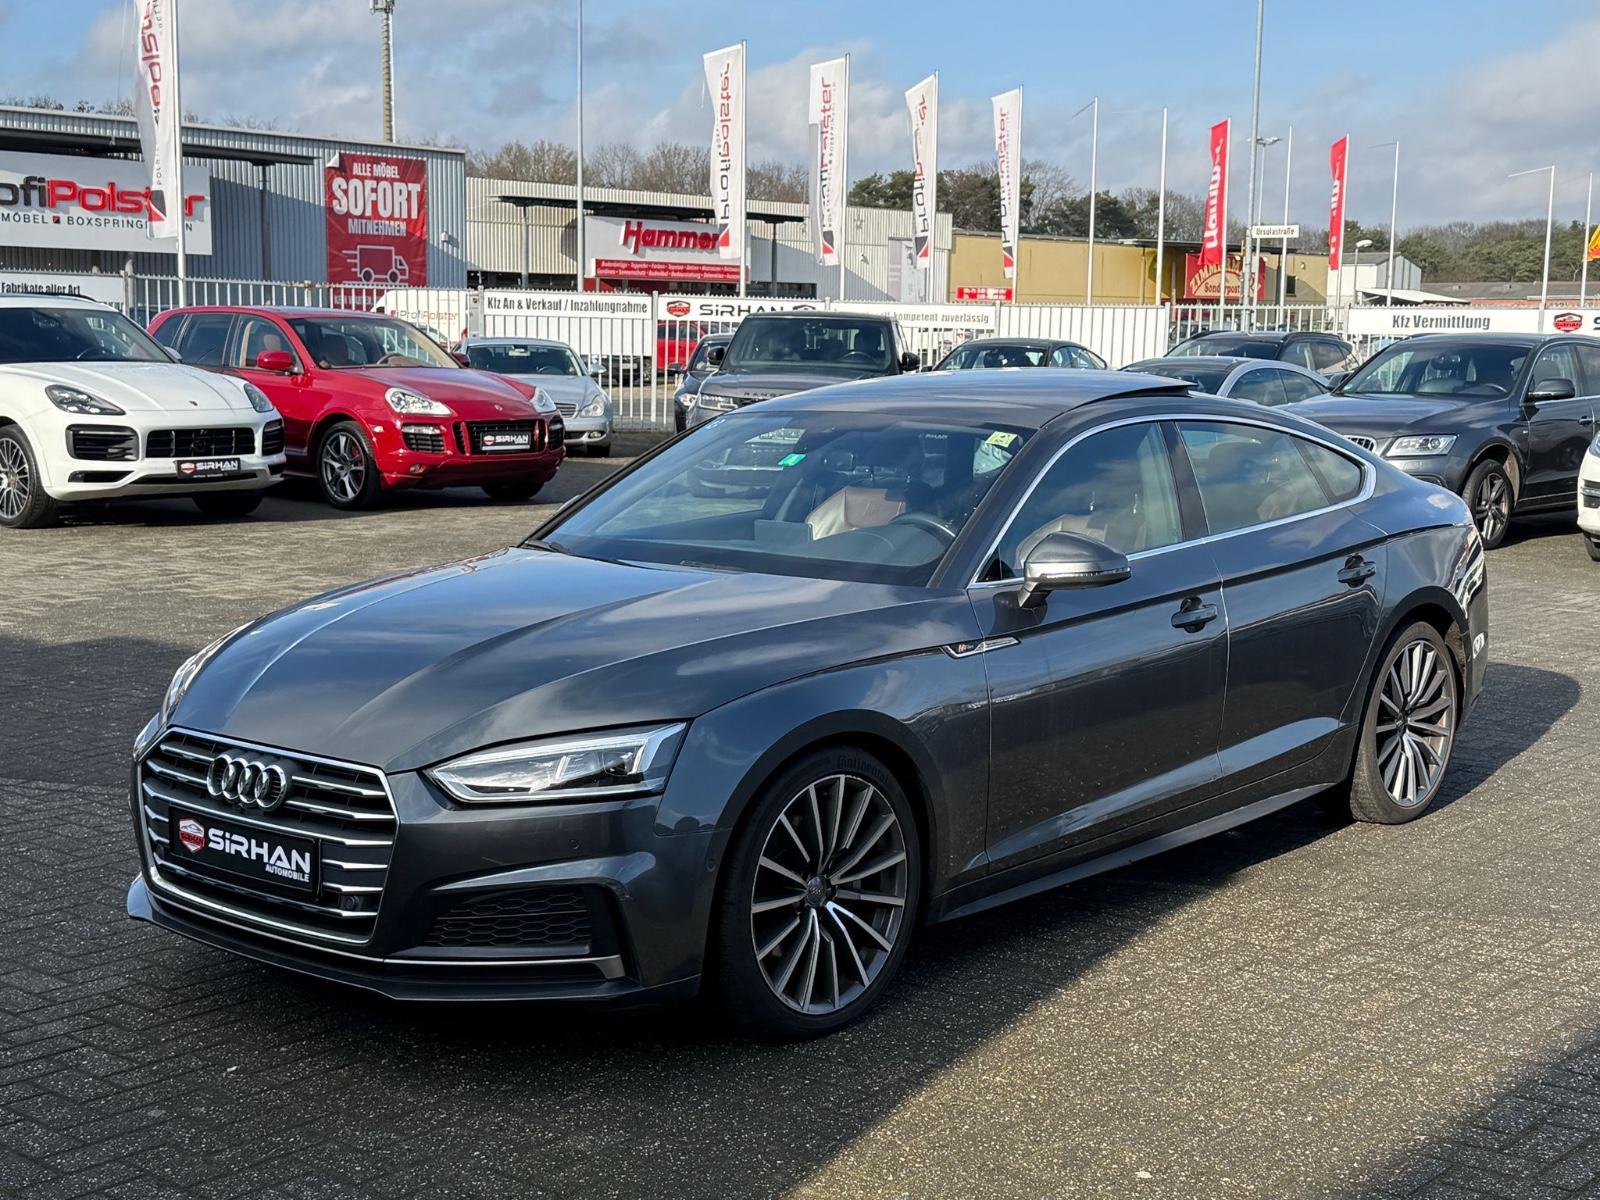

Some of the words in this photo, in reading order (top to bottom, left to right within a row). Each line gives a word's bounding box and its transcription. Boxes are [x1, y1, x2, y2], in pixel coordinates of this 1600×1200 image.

[352, 163, 371, 177] ALLE
[373, 162, 400, 178] MÖBEL
[332, 177, 421, 219] SOFORT
[348, 218, 407, 237] MITNEHMEN
[622, 220, 720, 255] Hammer
[1, 282, 44, 294] Fabrikate
[46, 284, 66, 295] aller
[68, 284, 81, 295] Art
[487, 297, 501, 309] Kfz
[503, 297, 515, 310] An
[517, 300, 523, 310] &
[526, 298, 562, 311] Verkauf
[570, 300, 648, 313] Inzahlungnahme
[941, 313, 989, 323] zuverlässig
[1392, 315, 1410, 328] Kfz
[1413, 315, 1491, 330] Vermittlung
[265, 864, 309, 882] AUTOMOBILE
